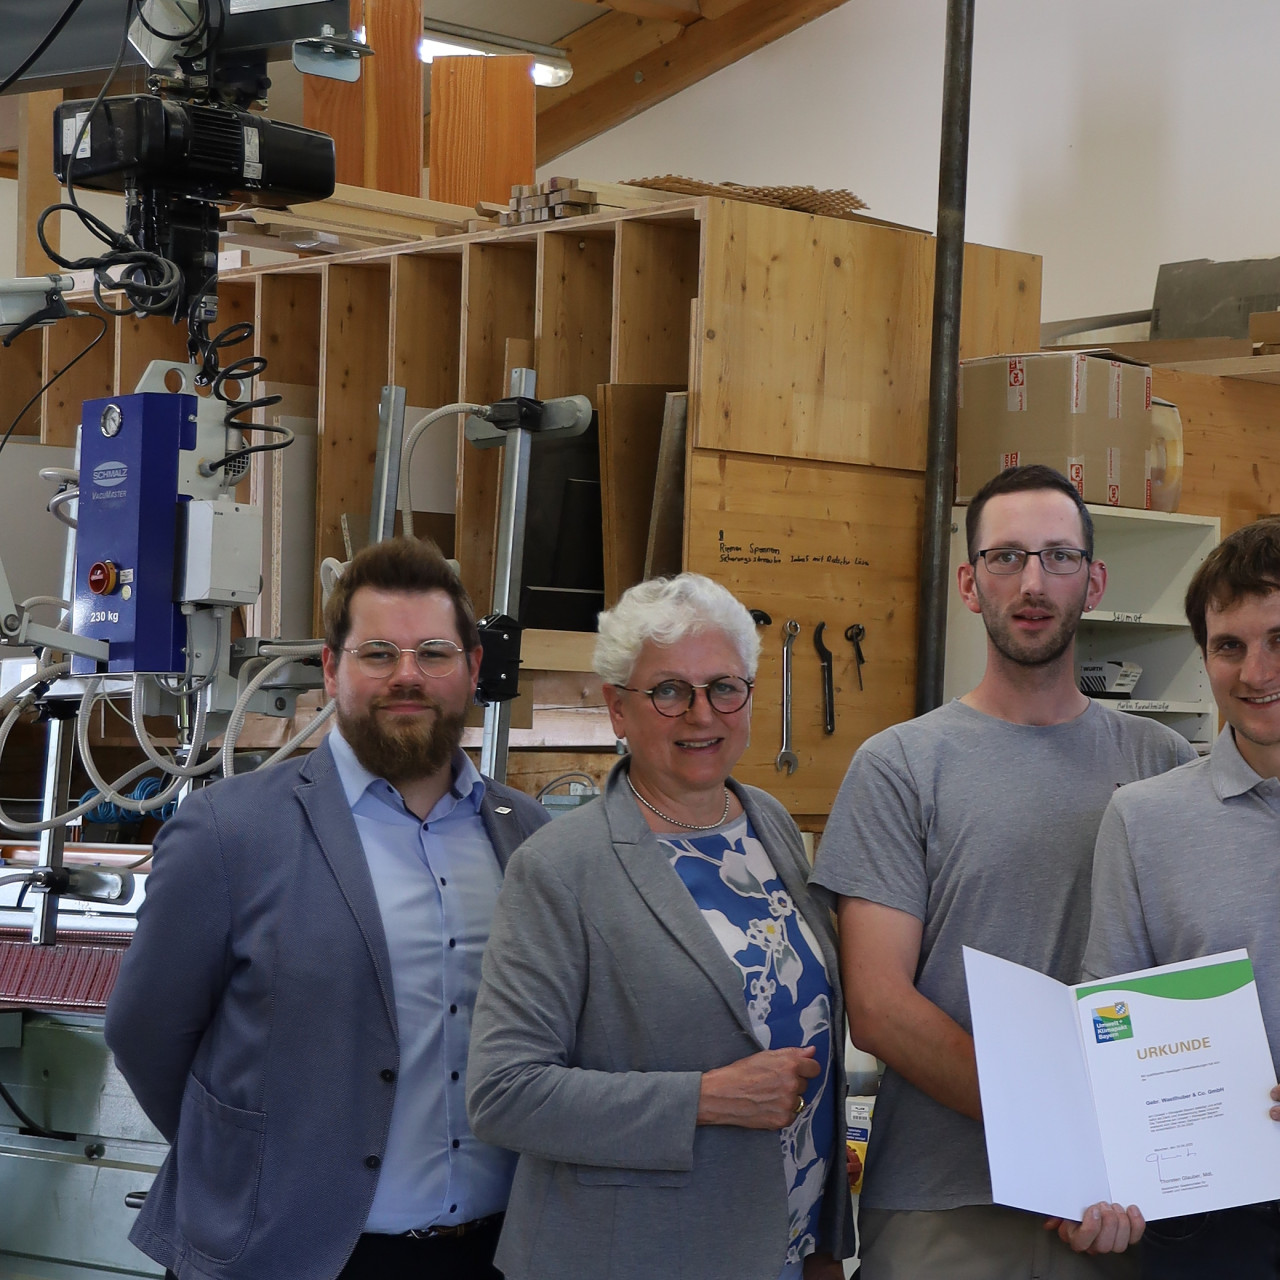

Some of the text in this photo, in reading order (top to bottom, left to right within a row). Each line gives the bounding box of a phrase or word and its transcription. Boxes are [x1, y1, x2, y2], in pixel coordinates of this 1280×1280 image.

[92, 469, 128, 480] SCHMALZ
[90, 611, 119, 623] 230 kg
[1098, 1032, 1119, 1040] Bayern
[1136, 1036, 1212, 1060] URKUNDE
[1207, 1087, 1225, 1095] GmbH
